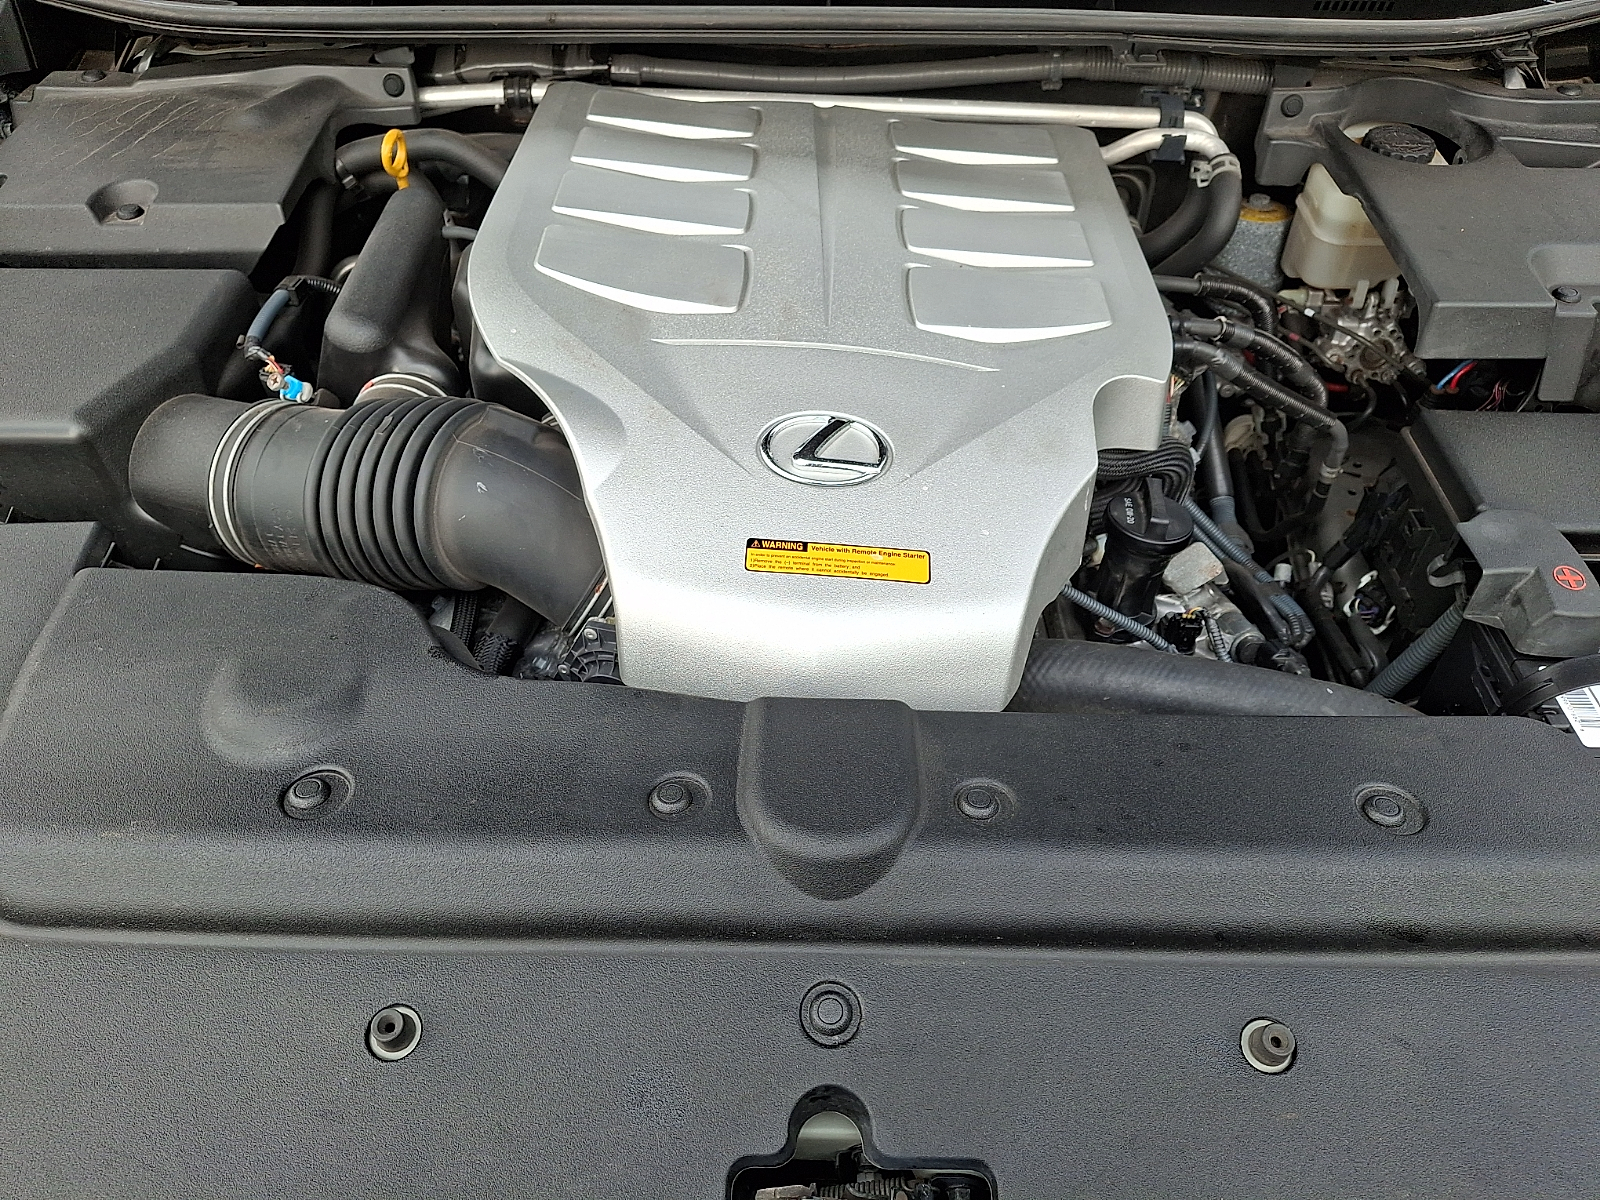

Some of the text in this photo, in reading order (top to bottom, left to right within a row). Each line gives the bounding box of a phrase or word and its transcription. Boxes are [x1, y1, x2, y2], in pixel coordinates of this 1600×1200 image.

[761, 540, 804, 550] WARNING
[852, 548, 877, 556] Remote
[879, 550, 902, 558] Engine
